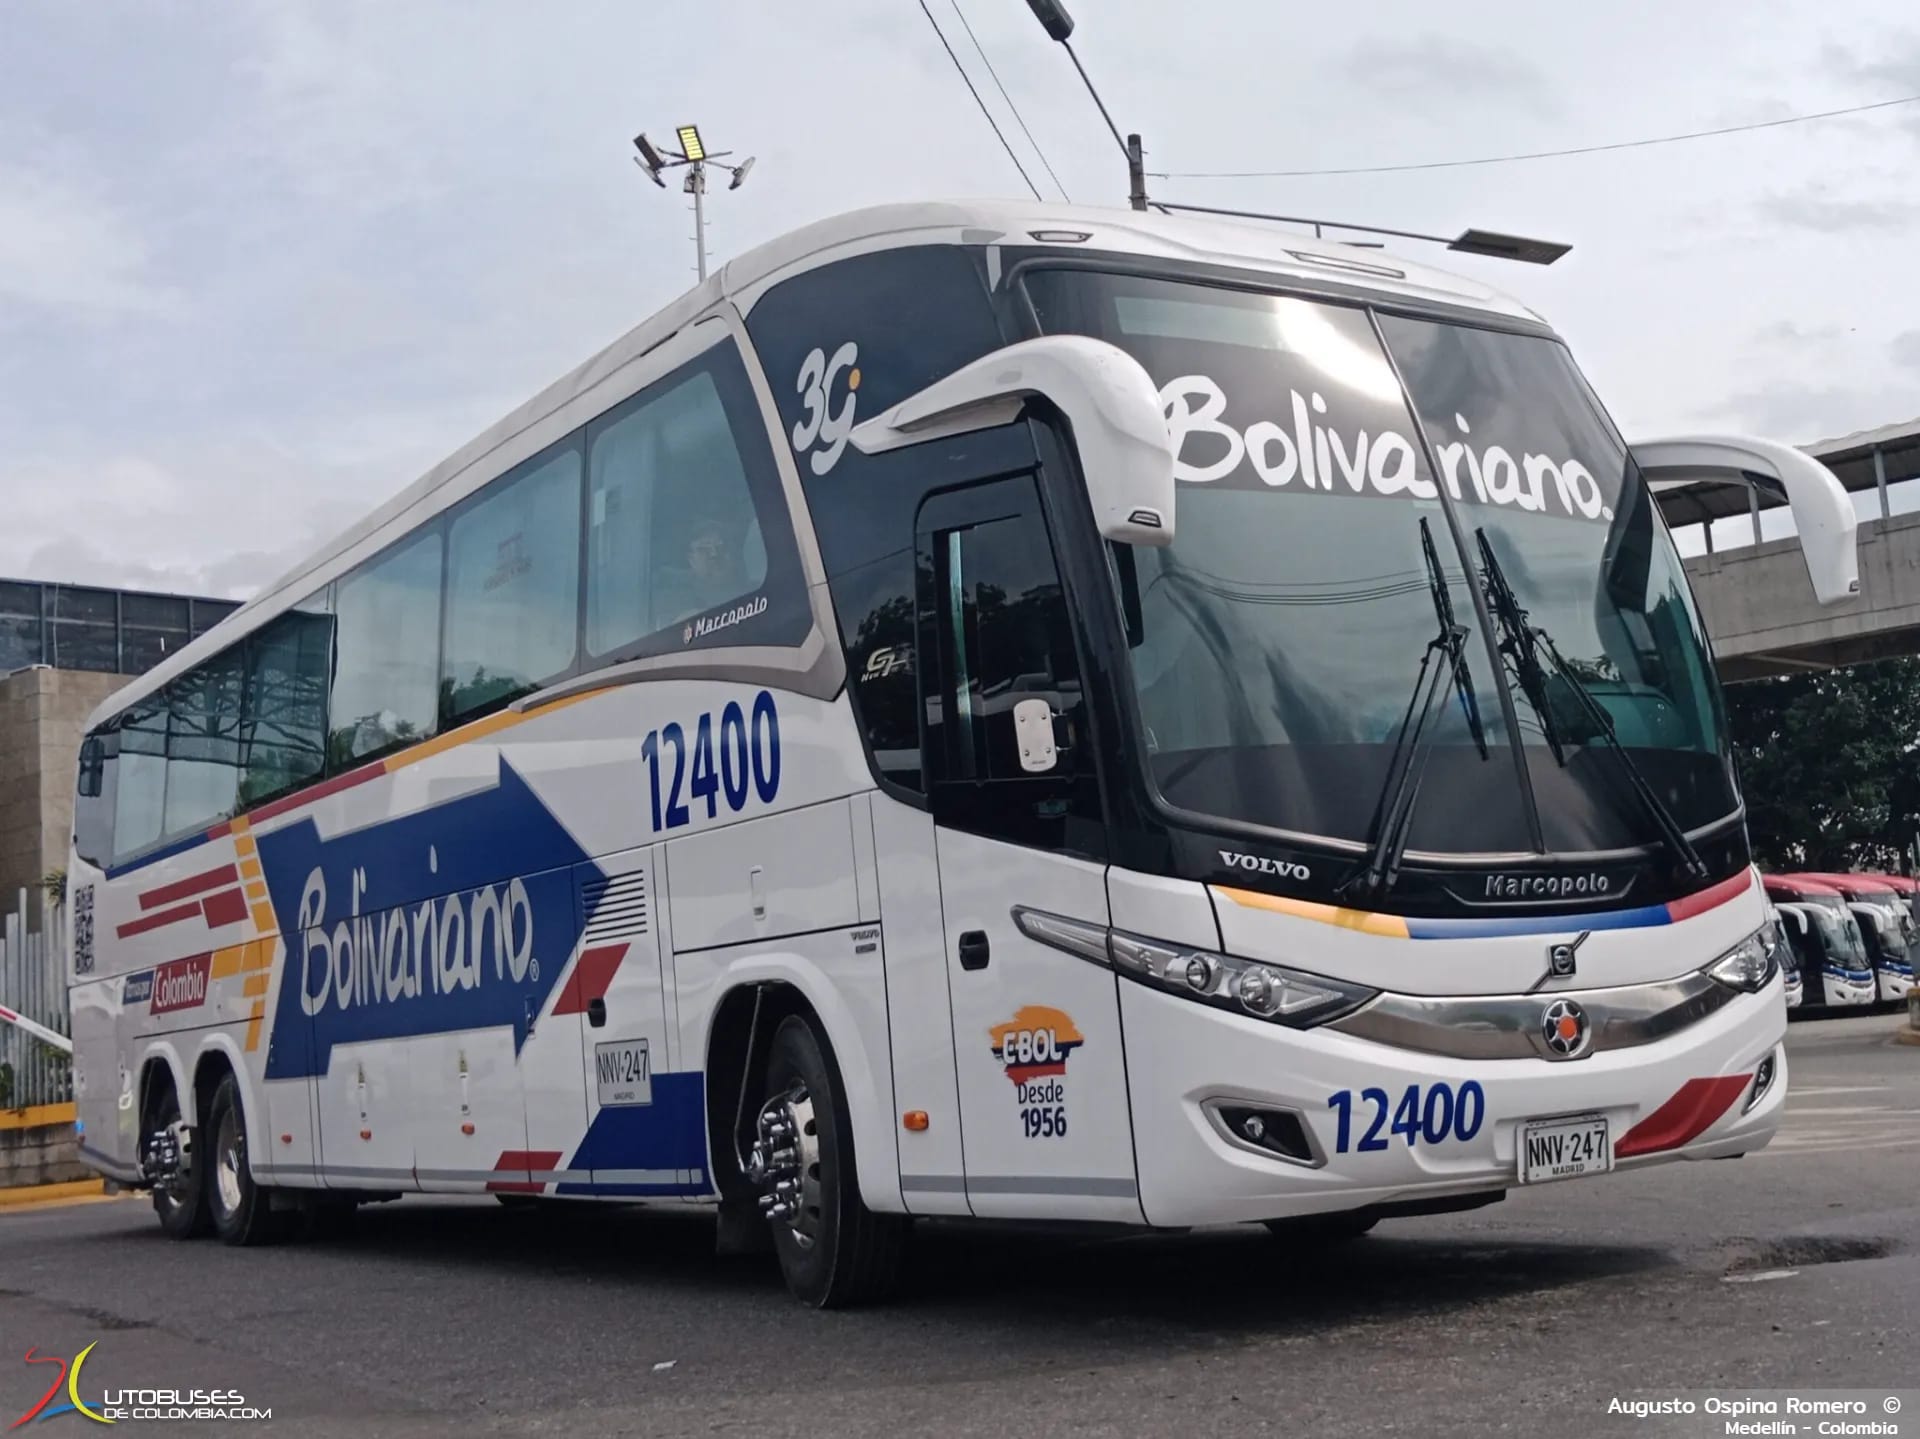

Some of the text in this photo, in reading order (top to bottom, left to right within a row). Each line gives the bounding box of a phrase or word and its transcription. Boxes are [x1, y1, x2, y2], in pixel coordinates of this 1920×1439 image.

[695, 597, 768, 637] Marcopolo
[641, 690, 781, 832] 12400
[1218, 850, 1311, 880] VOLVO
[1485, 873, 1609, 896] Marcopolo
[155, 963, 204, 1008] Colombia
[1018, 1079, 1064, 1104] Desde
[1020, 1106, 1067, 1138] 1956
[1328, 1080, 1484, 1153] 12400
[1552, 1163, 1585, 1175] MADRID
